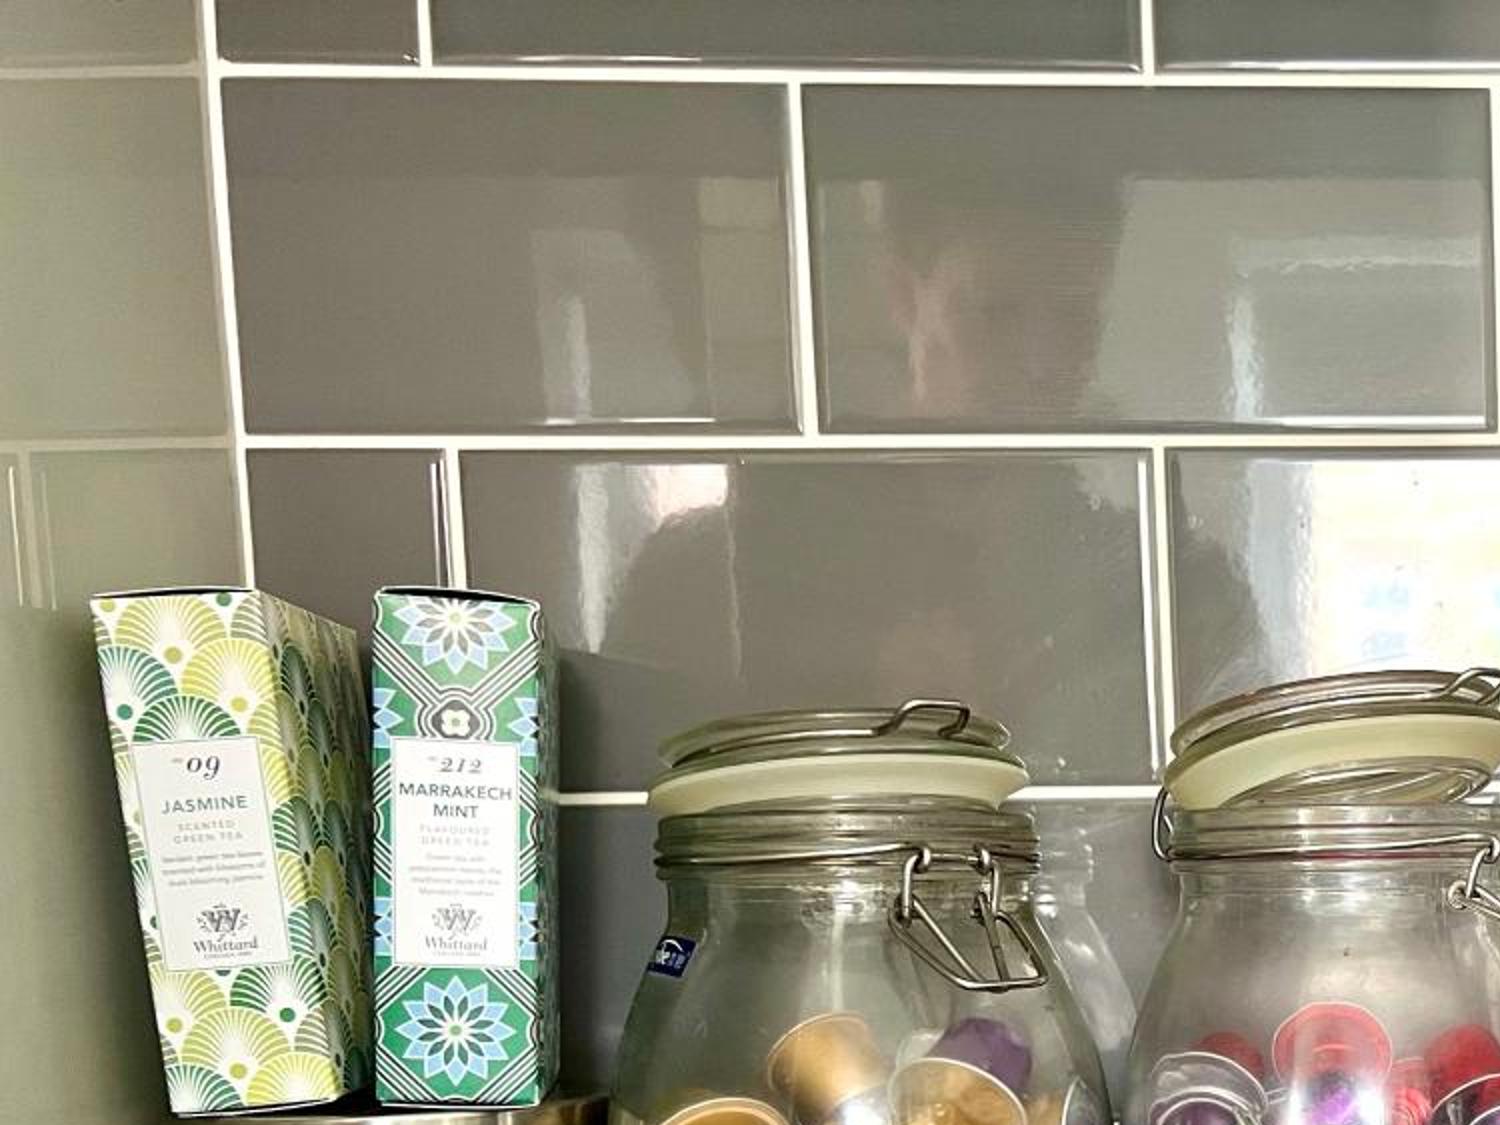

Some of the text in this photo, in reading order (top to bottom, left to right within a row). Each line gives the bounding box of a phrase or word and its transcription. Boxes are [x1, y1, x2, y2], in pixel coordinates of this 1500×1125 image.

[399, 782, 512, 801] MARRAKECH
[161, 795, 249, 815] JASMINE
[433, 803, 479, 819] MINT
[192, 936, 259, 953] Whittard
[425, 935, 487, 951] Whittard
